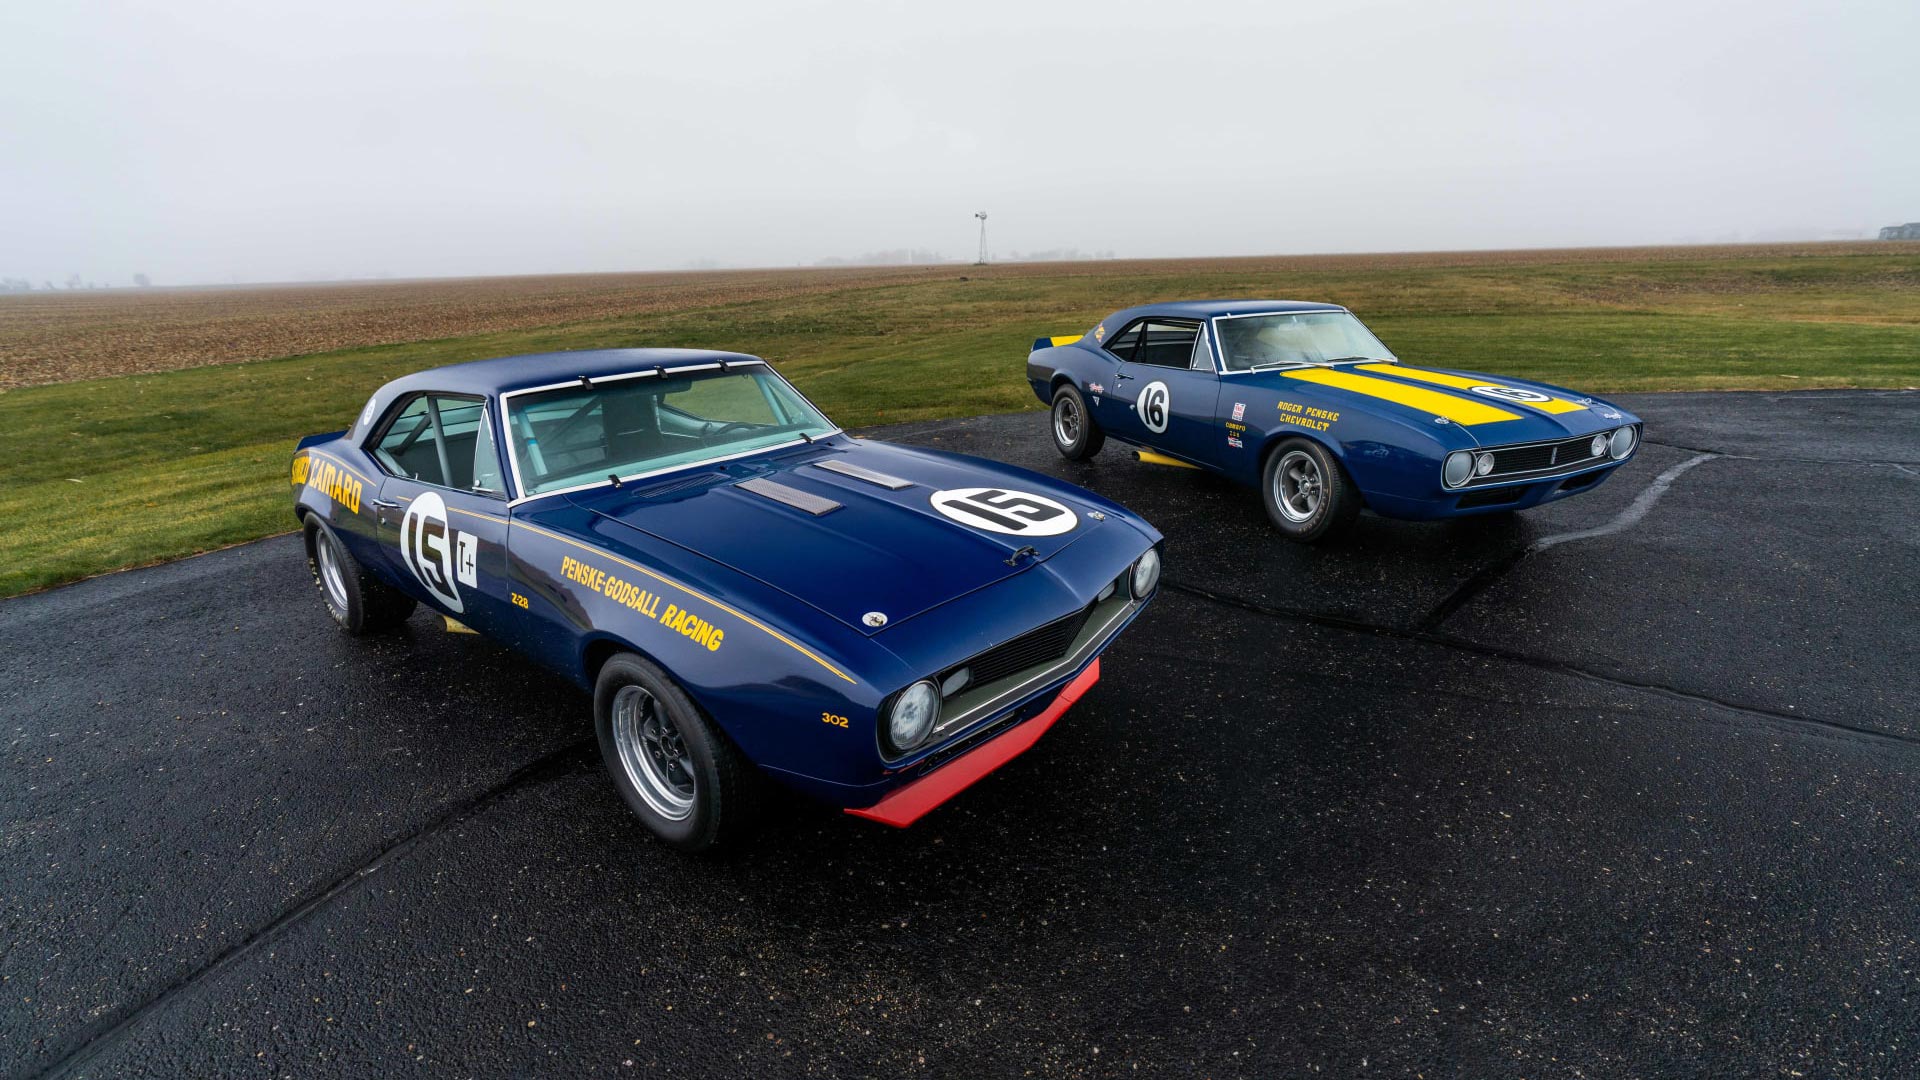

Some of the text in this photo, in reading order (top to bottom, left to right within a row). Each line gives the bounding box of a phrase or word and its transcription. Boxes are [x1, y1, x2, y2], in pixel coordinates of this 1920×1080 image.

[1143, 387, 1165, 428] 16
[1277, 401, 1340, 422] ROGER PENSKE
[1279, 413, 1330, 432] CHEVROLET
[308, 458, 363, 515] CAMARO
[942, 489, 1066, 532] 15
[407, 511, 458, 602] 15
[560, 555, 725, 652] PENSKE-GODSALL RACING
[821, 712, 849, 729] 302
